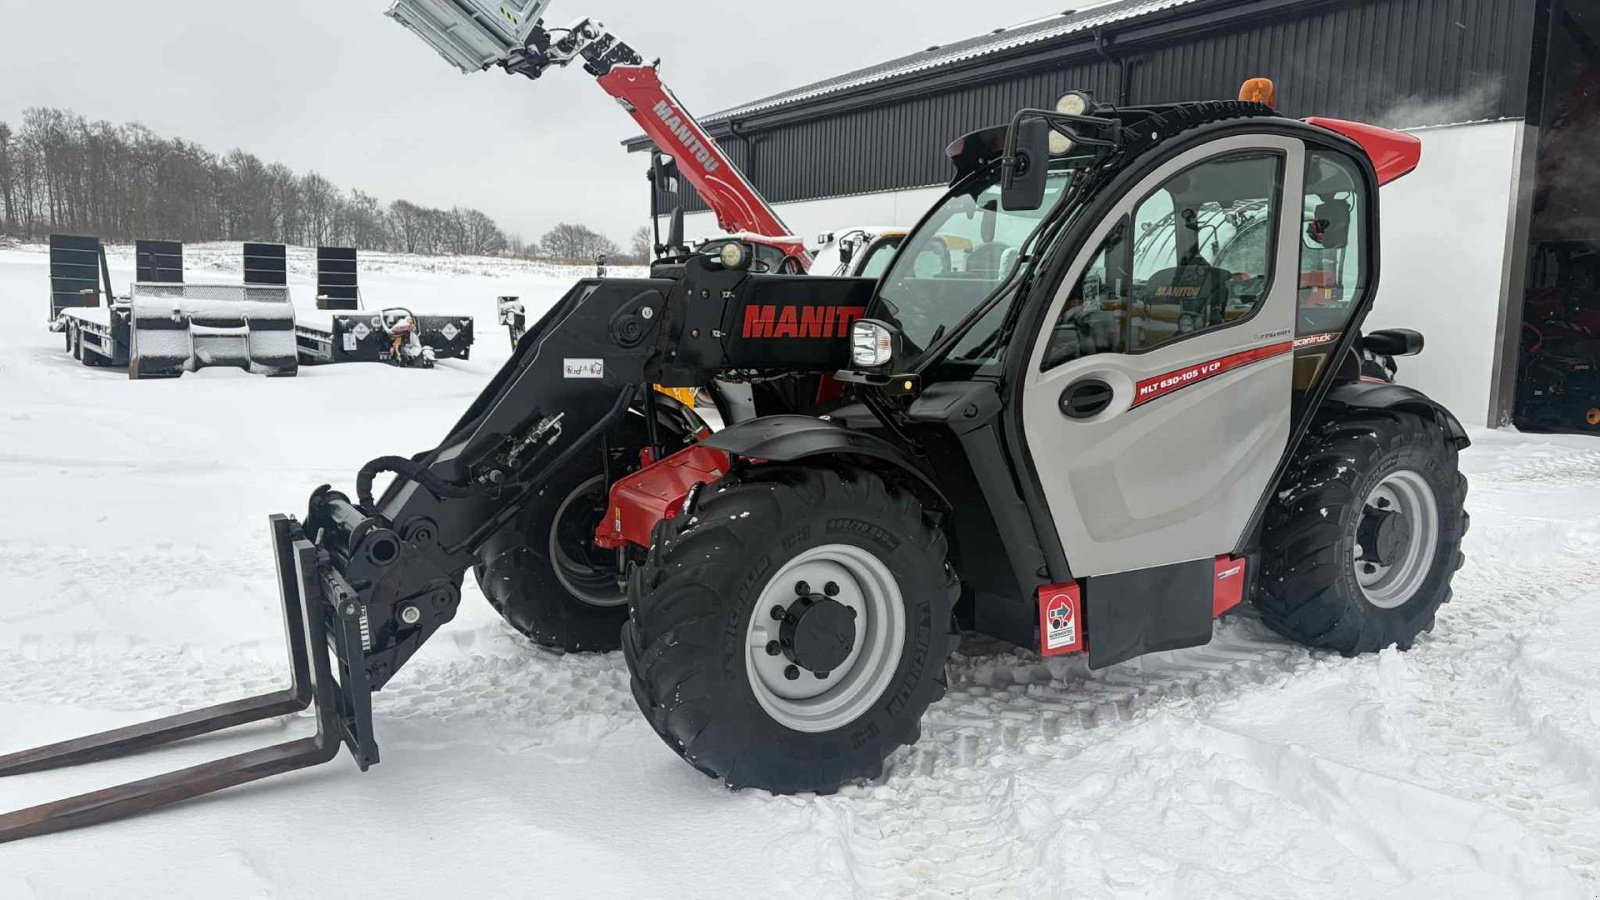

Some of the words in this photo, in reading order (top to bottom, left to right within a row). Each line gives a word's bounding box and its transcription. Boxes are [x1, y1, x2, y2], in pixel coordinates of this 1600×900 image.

[652, 100, 719, 172] MANITOU
[1155, 286, 1201, 296] MANITOU
[742, 304, 866, 338] MANIT
[1293, 333, 1332, 347] scantruck
[1140, 382, 1160, 396] MLT
[1159, 369, 1199, 389] 630-105
[1201, 366, 1209, 375] V
[1209, 362, 1221, 371] CP
